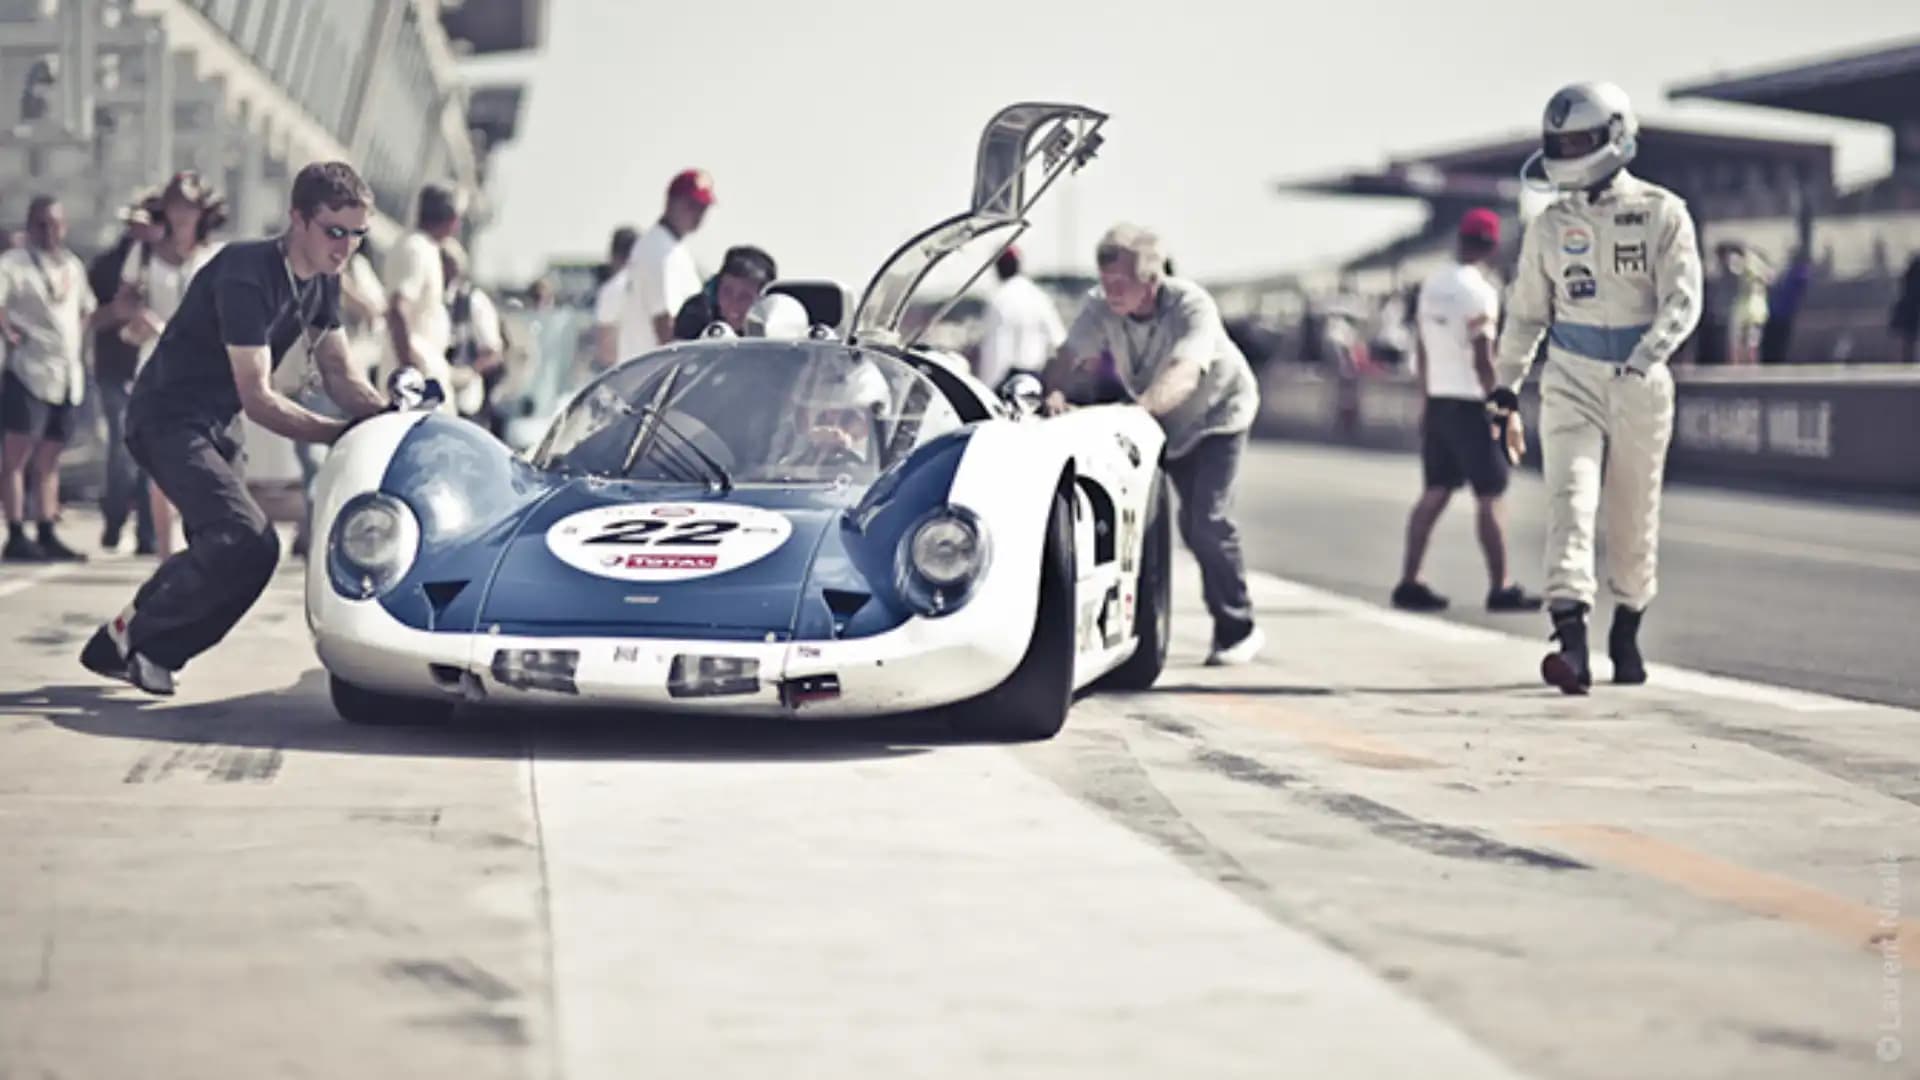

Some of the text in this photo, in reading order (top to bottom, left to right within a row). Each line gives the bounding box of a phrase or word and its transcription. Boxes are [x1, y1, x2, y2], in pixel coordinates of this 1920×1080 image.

[1767, 401, 1831, 459] MILLE
[581, 519, 740, 546] 22
[630, 555, 713, 568] TOTAL
